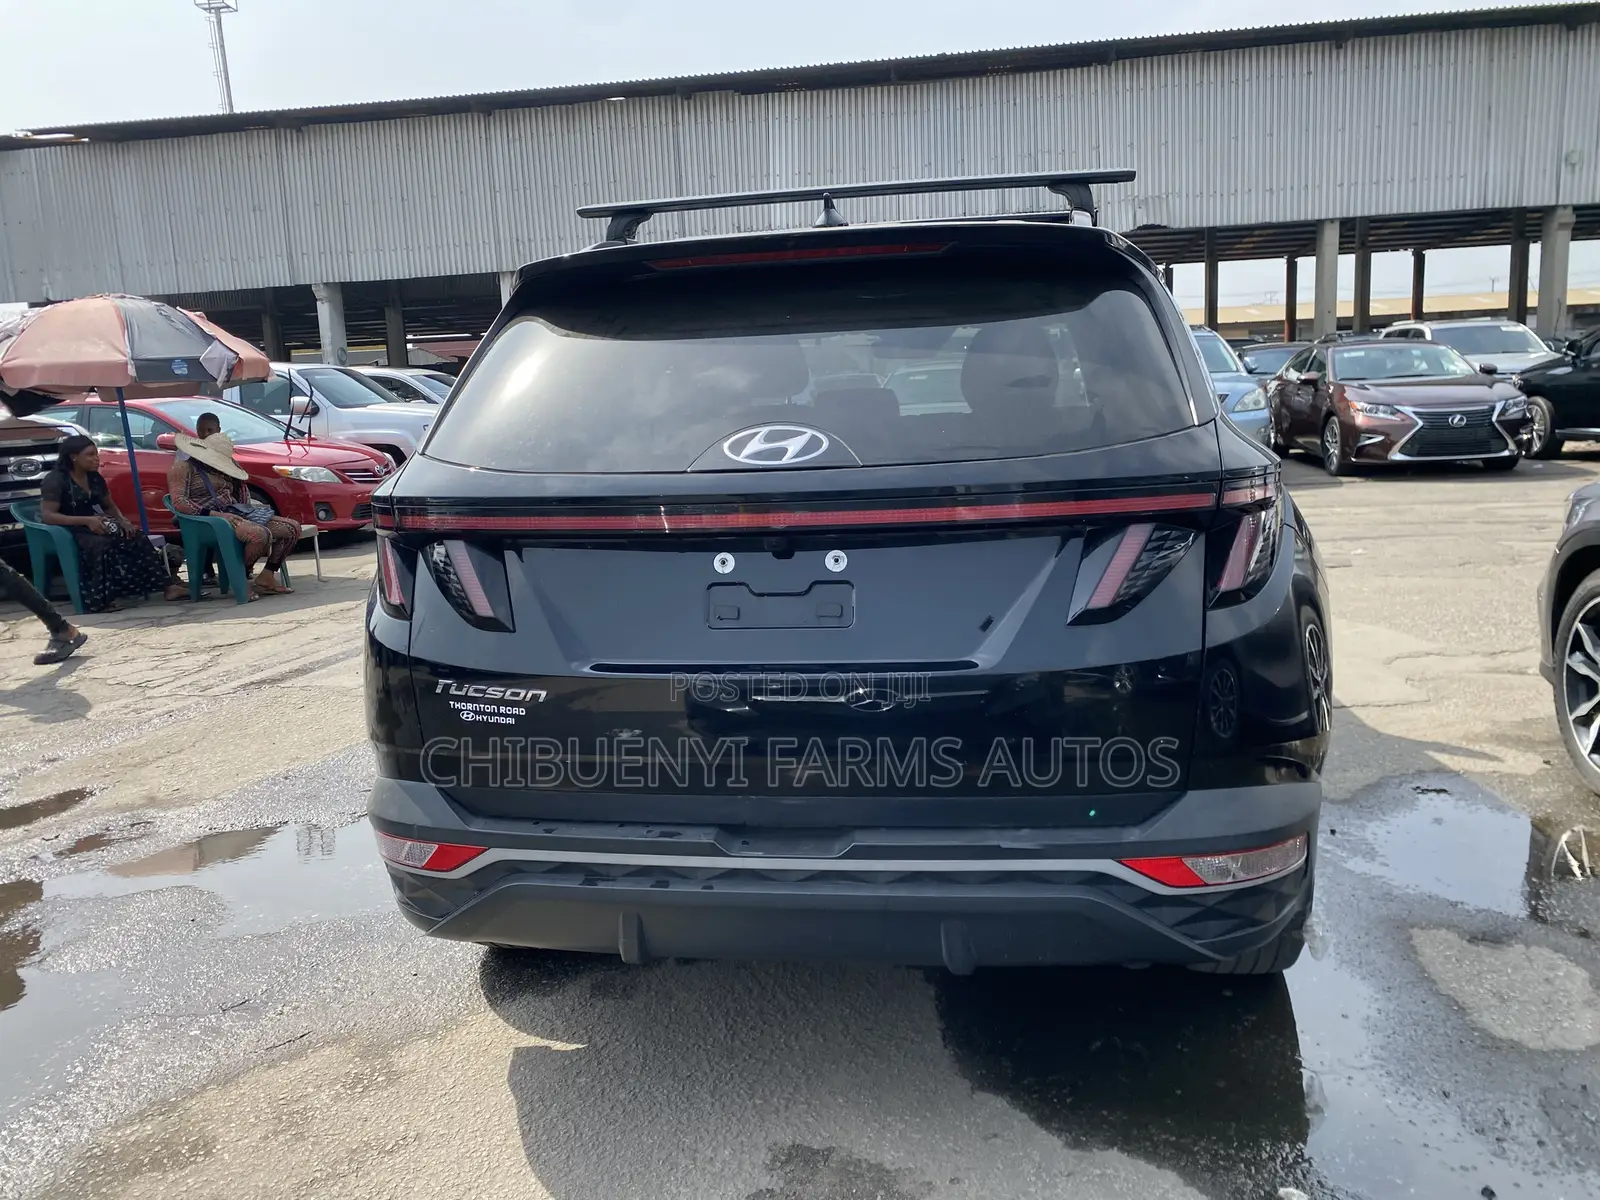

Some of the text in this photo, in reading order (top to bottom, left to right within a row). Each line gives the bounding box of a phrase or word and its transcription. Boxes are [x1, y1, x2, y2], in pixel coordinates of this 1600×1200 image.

[449, 701, 526, 716] THORNTON ROAD
[476, 714, 515, 724] HYUNDAI
